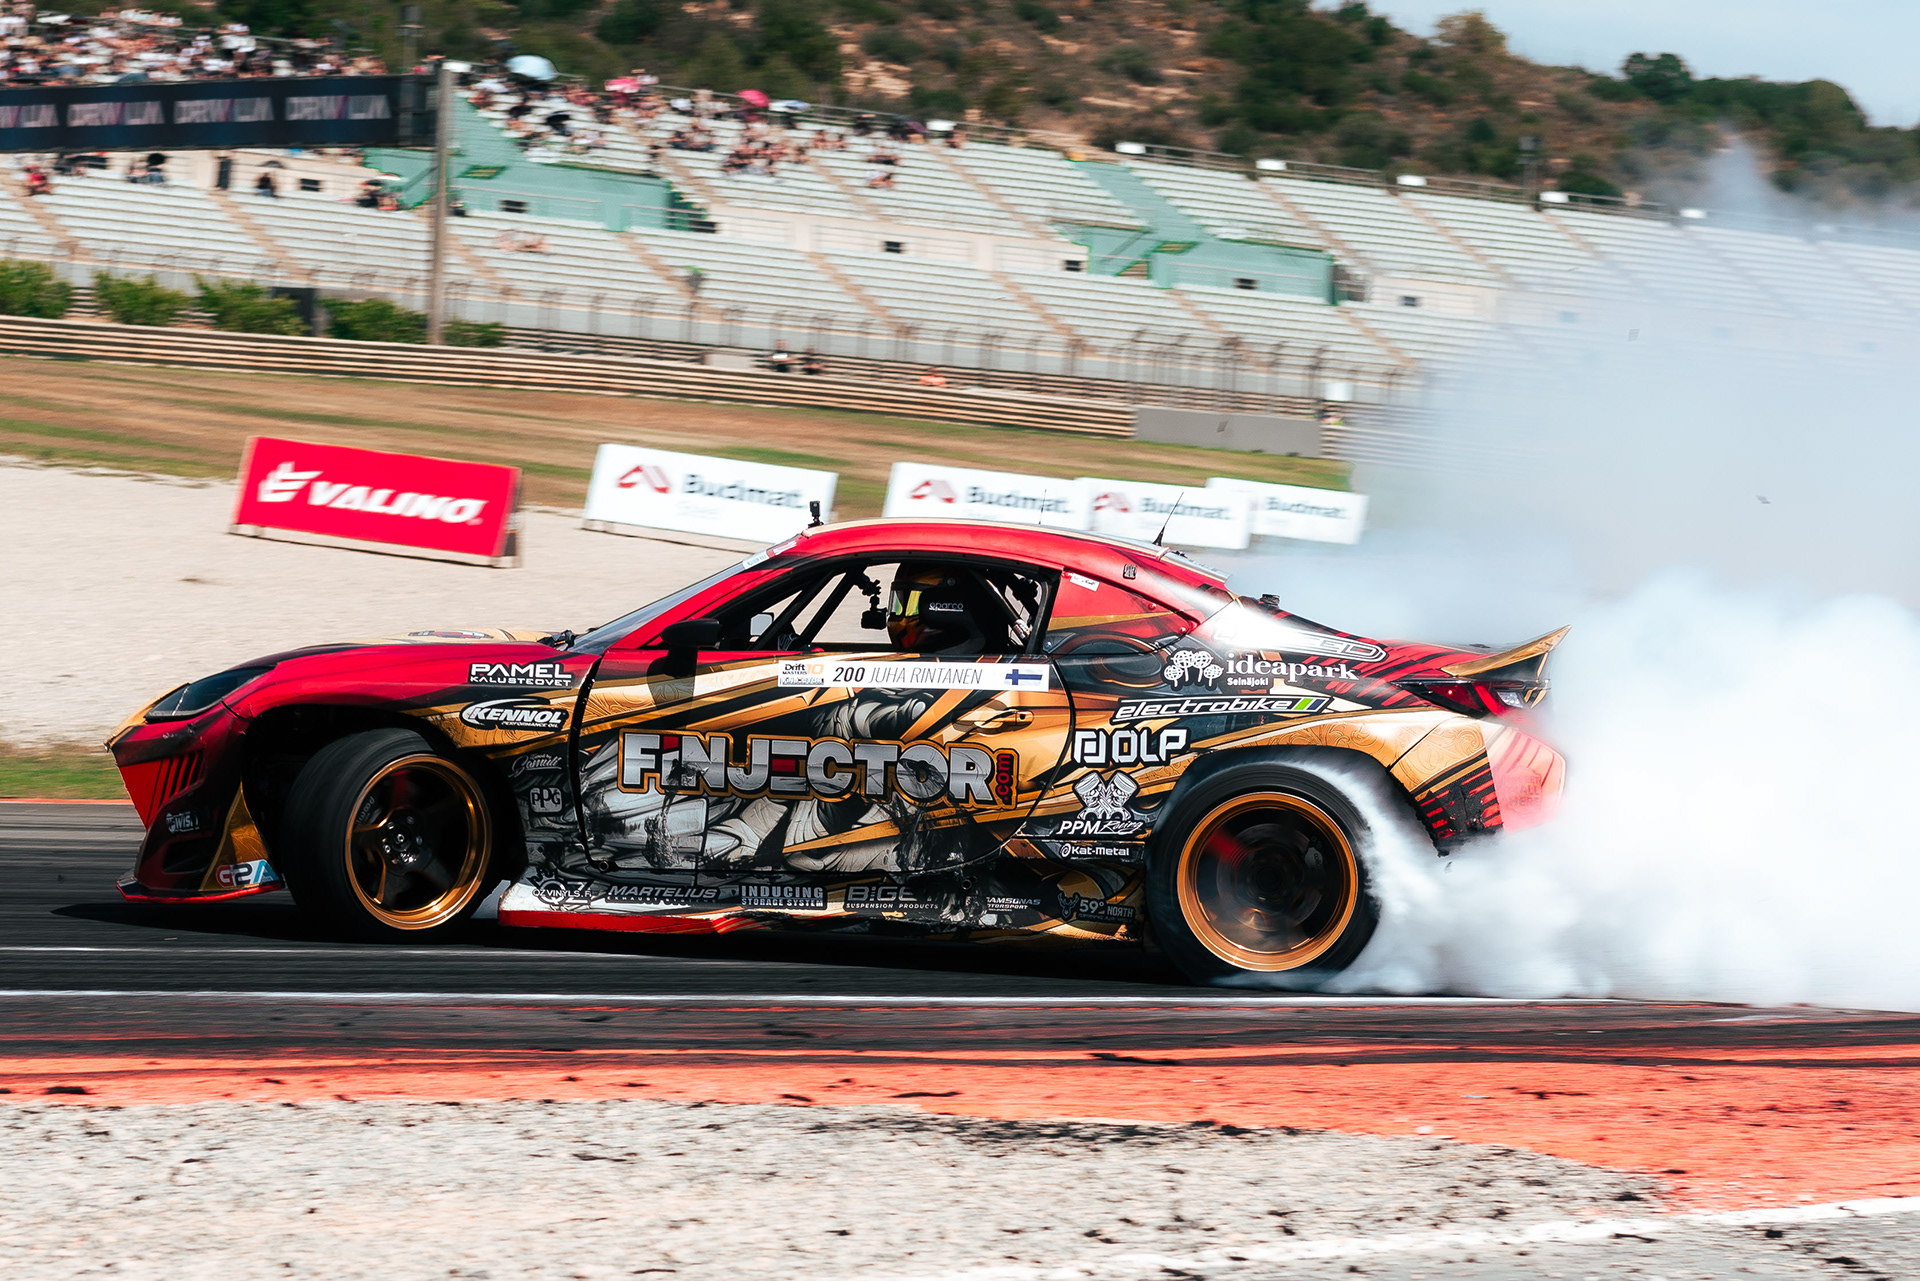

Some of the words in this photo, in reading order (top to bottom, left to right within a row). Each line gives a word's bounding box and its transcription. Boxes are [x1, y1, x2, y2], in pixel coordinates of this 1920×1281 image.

[307, 480, 489, 524] VALINO
[470, 663, 572, 679] PAMEL
[785, 663, 806, 671] Drift
[806, 663, 824, 674] 10
[1226, 652, 1359, 683] ideapark
[470, 676, 572, 687] KALUSTEOVET
[832, 667, 865, 682] 200
[868, 667, 906, 684] JUHA
[910, 668, 983, 685] RINTANEN
[1227, 677, 1269, 688] Seinäjoki
[470, 707, 562, 724] KENNOL
[1115, 698, 1293, 719] electrobike
[996, 754, 1011, 801] .com
[531, 787, 562, 811] PPG
[1056, 820, 1099, 835] PPM
[1098, 820, 1144, 835] Racing
[1071, 846, 1129, 856] Kat-Metal
[608, 885, 718, 899] MARTELIUS
[741, 885, 824, 899] INDUCING
[741, 898, 784, 907] STORAGE
[786, 899, 824, 907] SYSTEM
